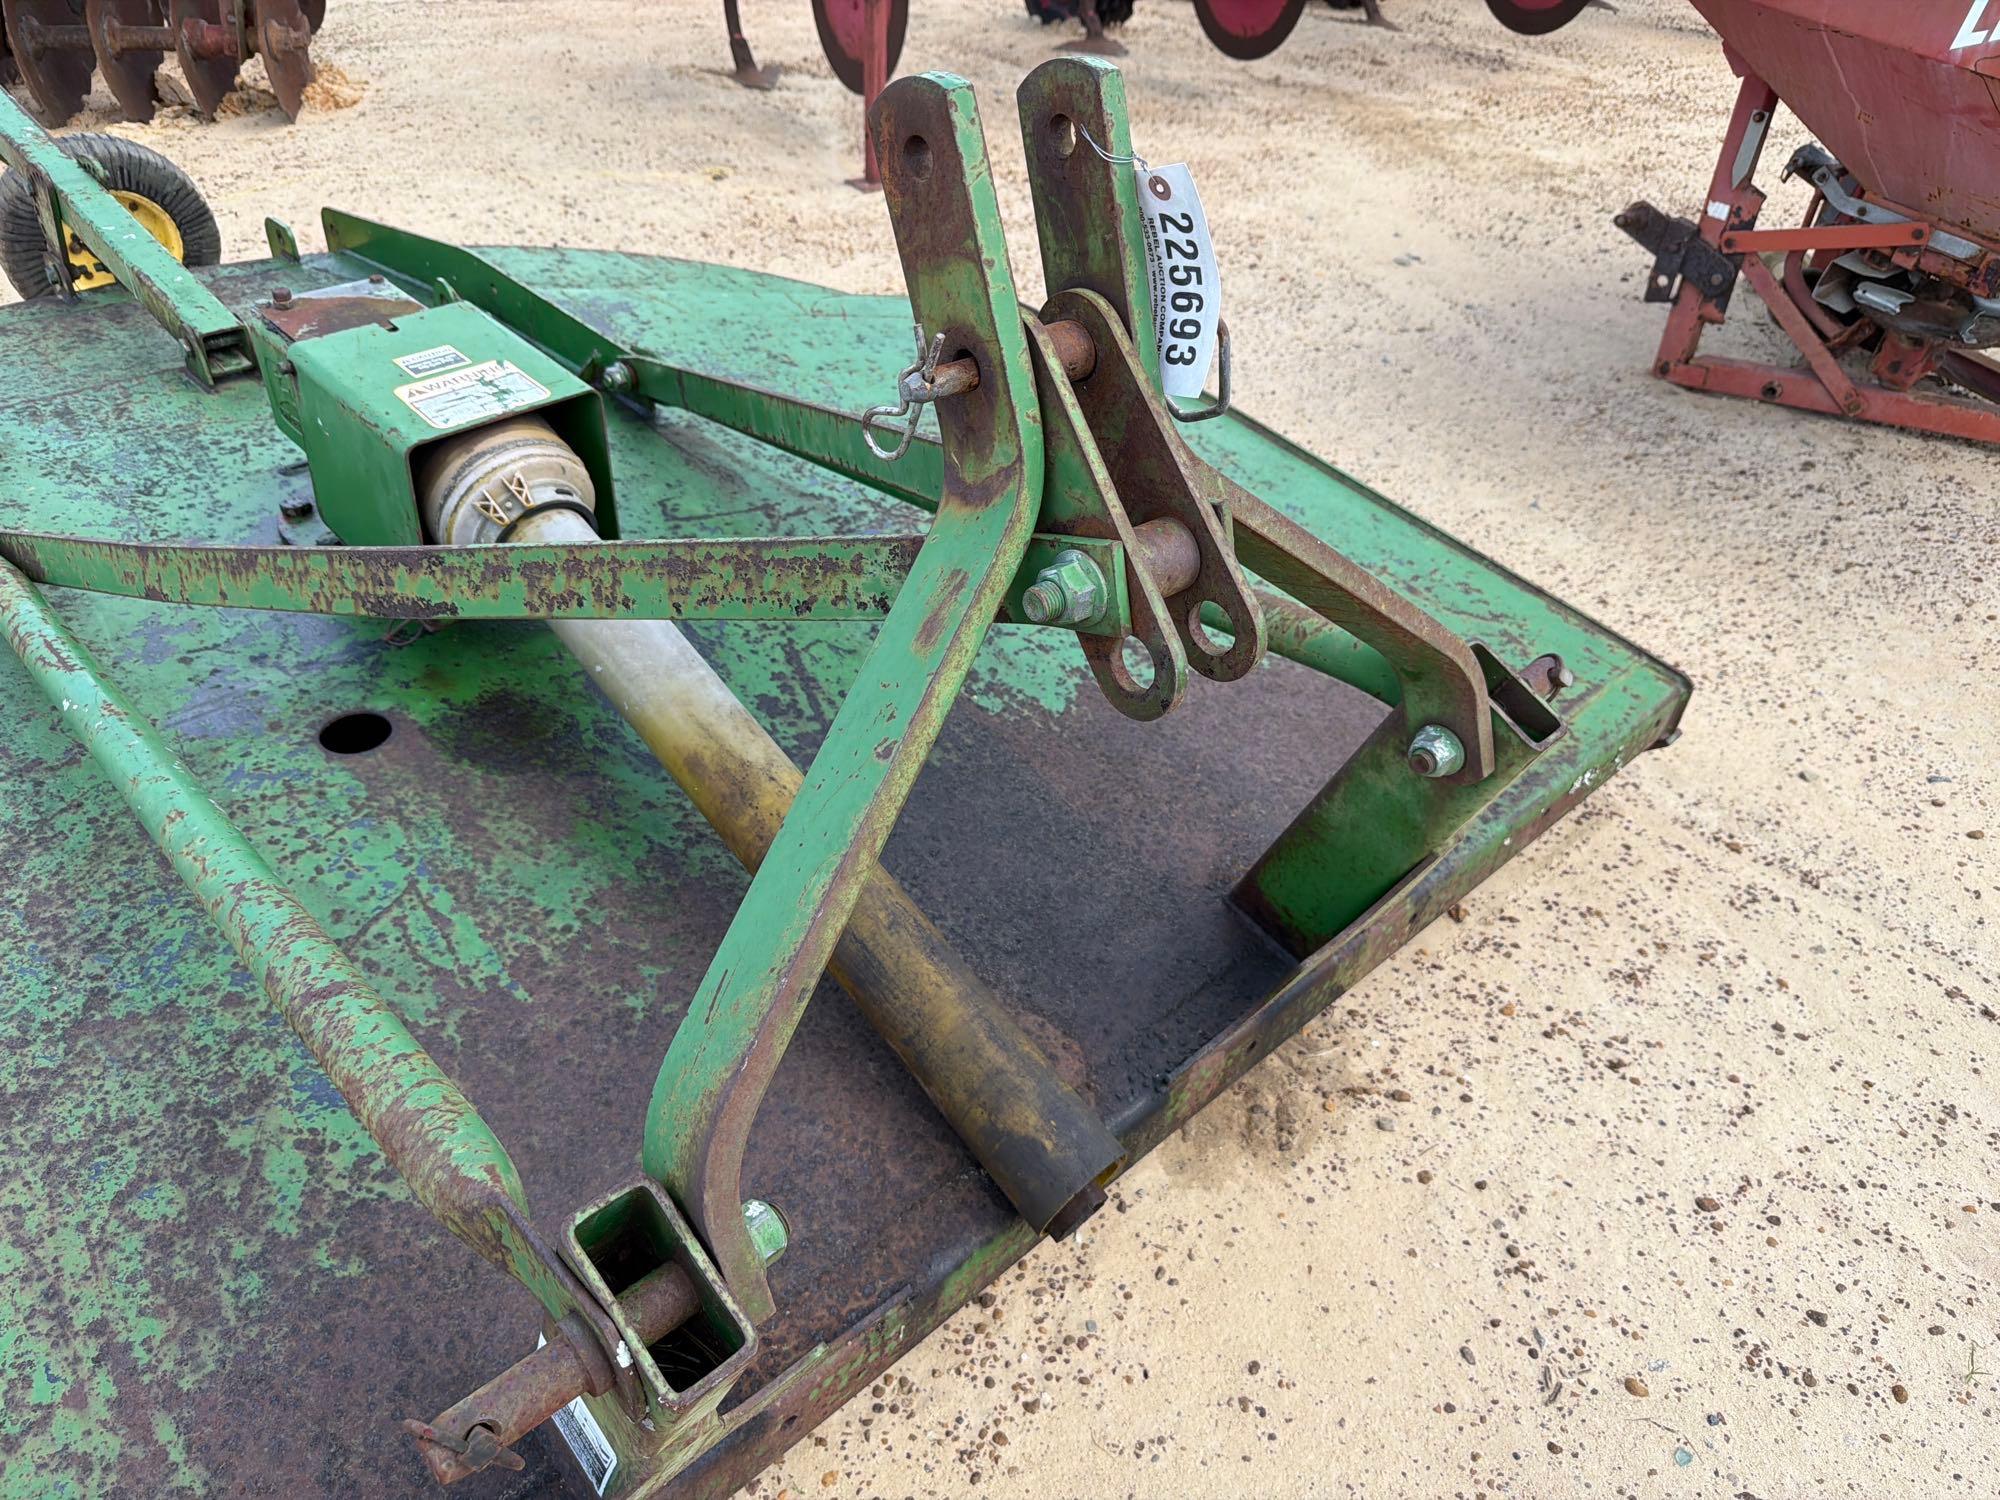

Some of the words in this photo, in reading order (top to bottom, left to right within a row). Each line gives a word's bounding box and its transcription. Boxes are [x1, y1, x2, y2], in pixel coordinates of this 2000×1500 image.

[1147, 217, 1160, 251] REBEL
[1155, 254, 1167, 302] AUCTION
[1159, 213, 1204, 366] 225693
